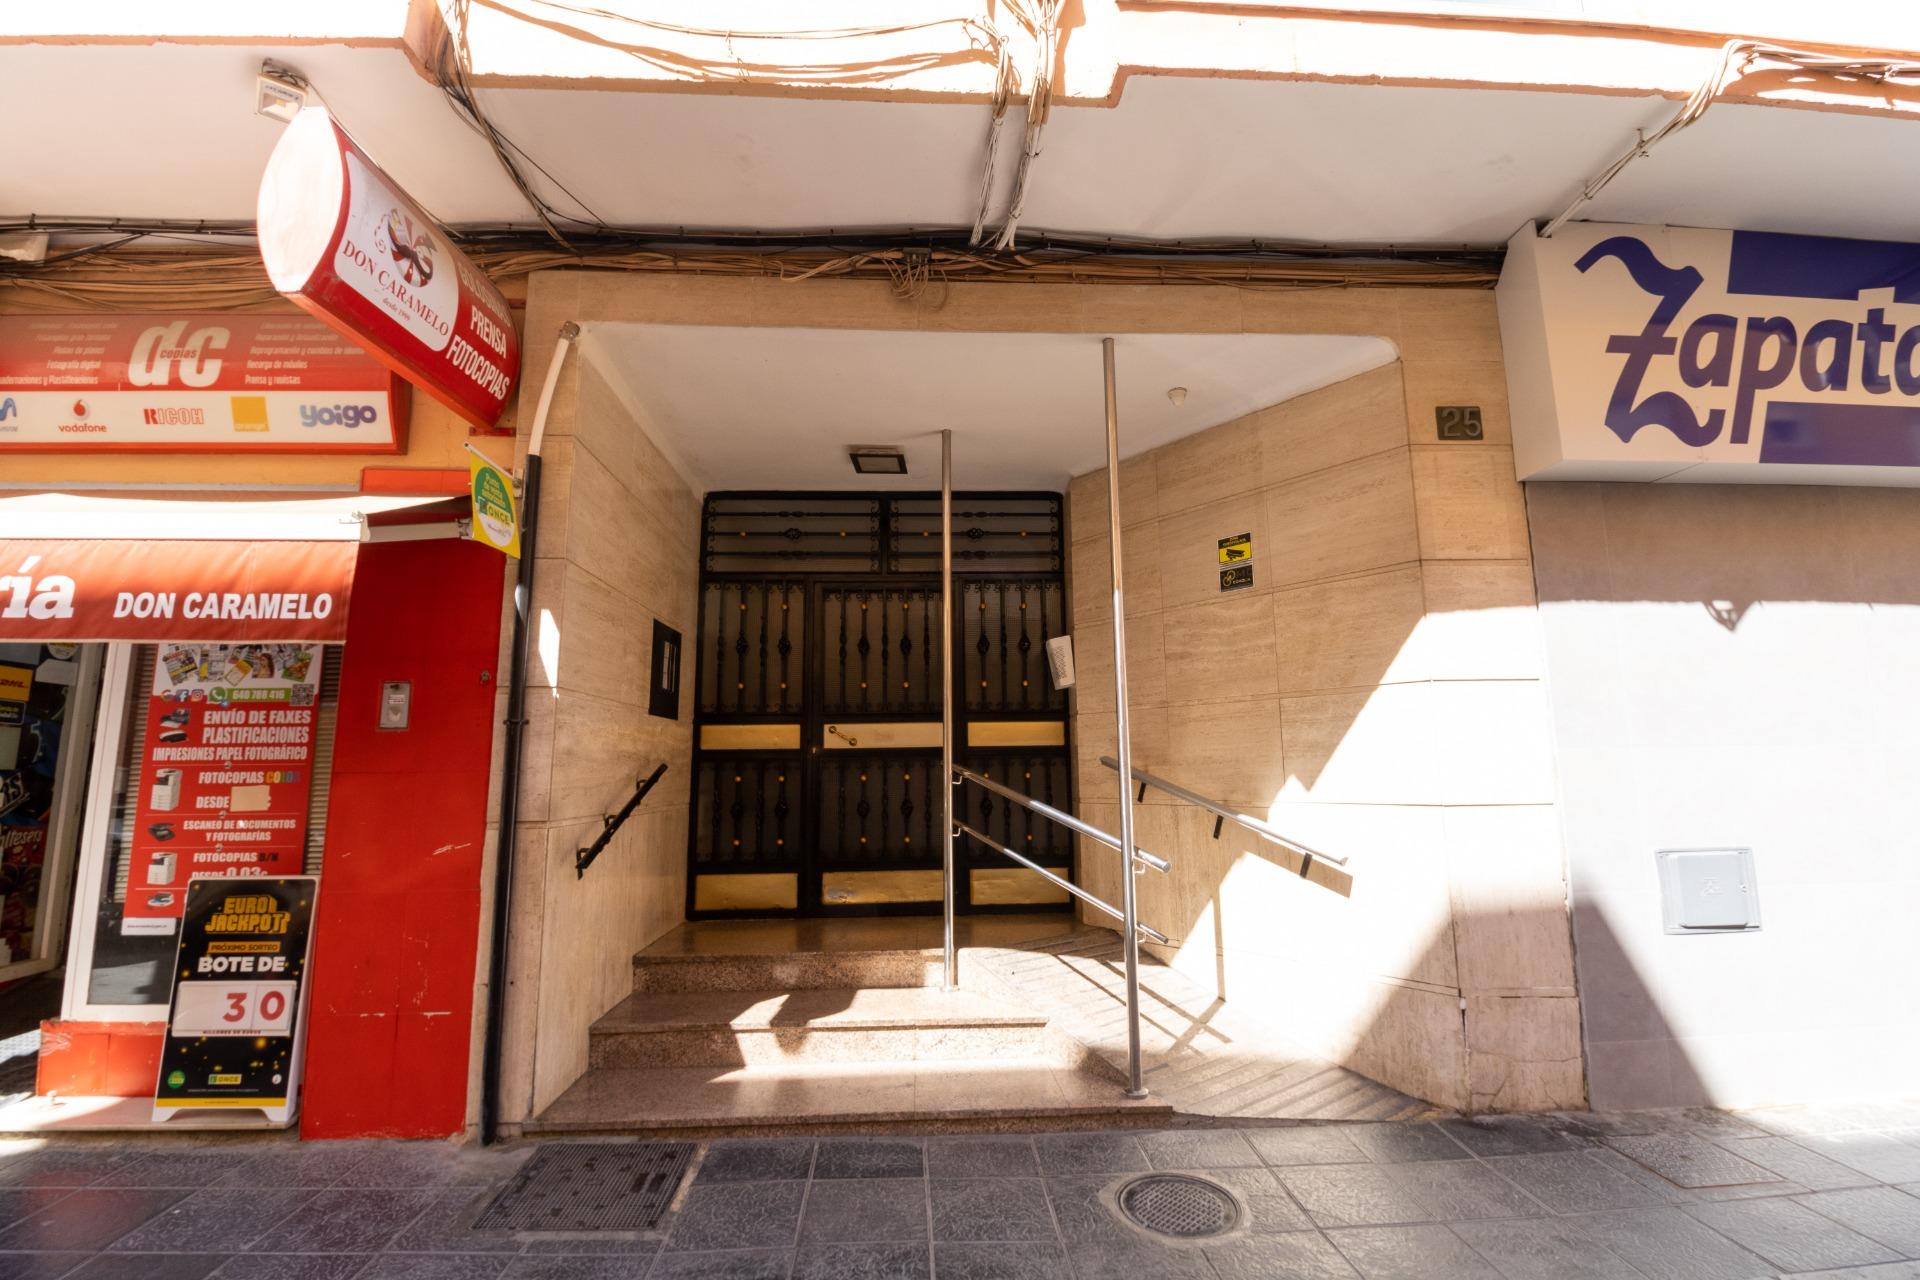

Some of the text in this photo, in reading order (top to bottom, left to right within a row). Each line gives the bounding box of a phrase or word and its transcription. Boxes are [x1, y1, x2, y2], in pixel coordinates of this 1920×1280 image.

[343, 240, 449, 336] DON CARAMELO
[470, 305, 507, 359] PRENSA
[160, 349, 198, 359] copias
[246, 359, 273, 370] Recarga
[445, 334, 510, 401] FOTOCOPIAS
[245, 374, 267, 385] Prensa
[144, 408, 204, 425] RICOH
[300, 404, 378, 428] yoigo
[1440, 407, 1482, 438] 25
[58, 424, 107, 433] vodafone
[488, 504, 511, 526] ONCE
[113, 591, 333, 620] DON CARAMELO
[203, 708, 312, 725] ENVÍO DE FAXES
[202, 726, 310, 745] PLASTIFICACIONES
[152, 744, 308, 761] IMPRESIONES PAPEL FOTOGRÁFICO
[198, 771, 300, 785] FOTOCOPIAS COLOR
[196, 795, 230, 809] DESDE
[183, 820, 222, 830] ESCANEO
[223, 820, 236, 829] DE
[212, 831, 272, 842] FOTOGRAFÍAS
[193, 852, 257, 863] FOTOCOPIAS
[223, 896, 275, 914] EURO
[204, 912, 290, 934] JACKPOT
[211, 943, 279, 951] PRÓXIMO SORTEO
[197, 956, 286, 973] BOTE DE
